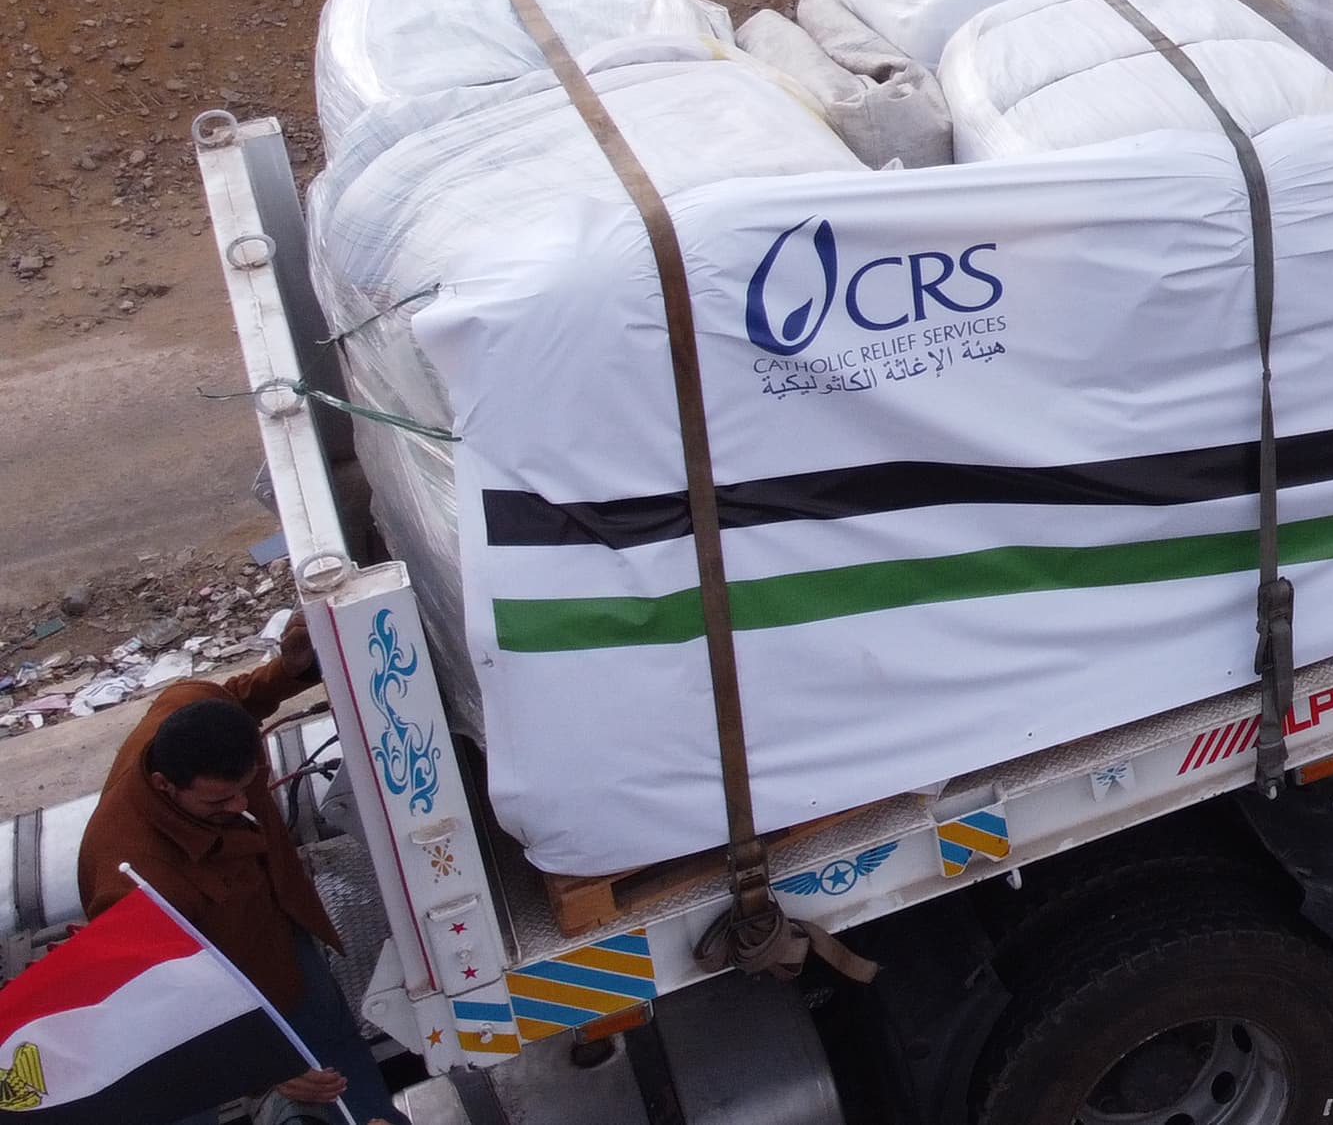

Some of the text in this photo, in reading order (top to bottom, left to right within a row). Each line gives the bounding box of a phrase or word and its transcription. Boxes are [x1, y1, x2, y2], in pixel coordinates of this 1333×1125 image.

[845, 242, 1004, 331] CRS
[753, 316, 1007, 375] CATHOLIC RELIEF SERVICES
[762, 339, 1007, 400] هيئة الإغاثة الكاثوليكية
